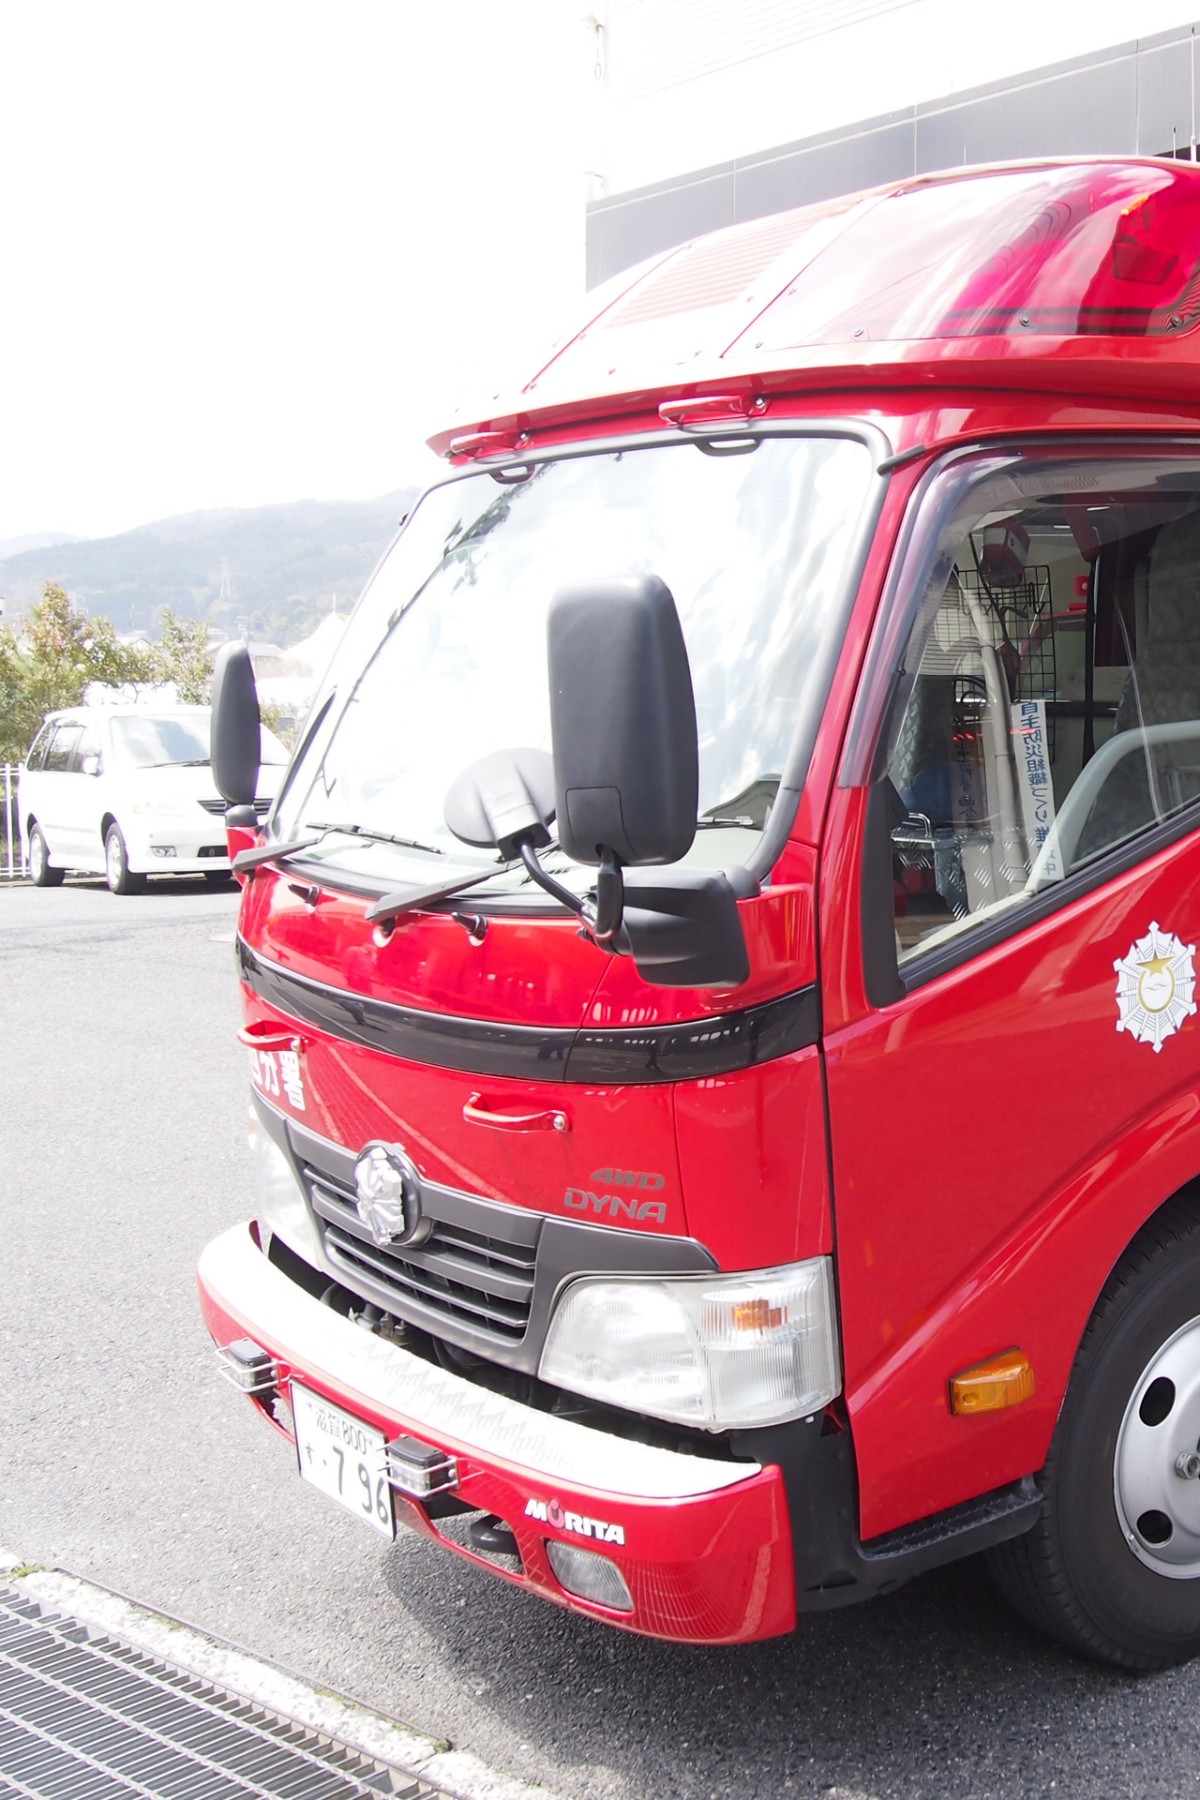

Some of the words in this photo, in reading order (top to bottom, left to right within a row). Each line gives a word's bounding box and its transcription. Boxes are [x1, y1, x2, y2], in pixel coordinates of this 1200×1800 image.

[590, 1167, 665, 1191] 4WD
[564, 1187, 667, 1224] DYNA
[342, 1420, 367, 1455] 800
[524, 1498, 625, 1547] MORITA
